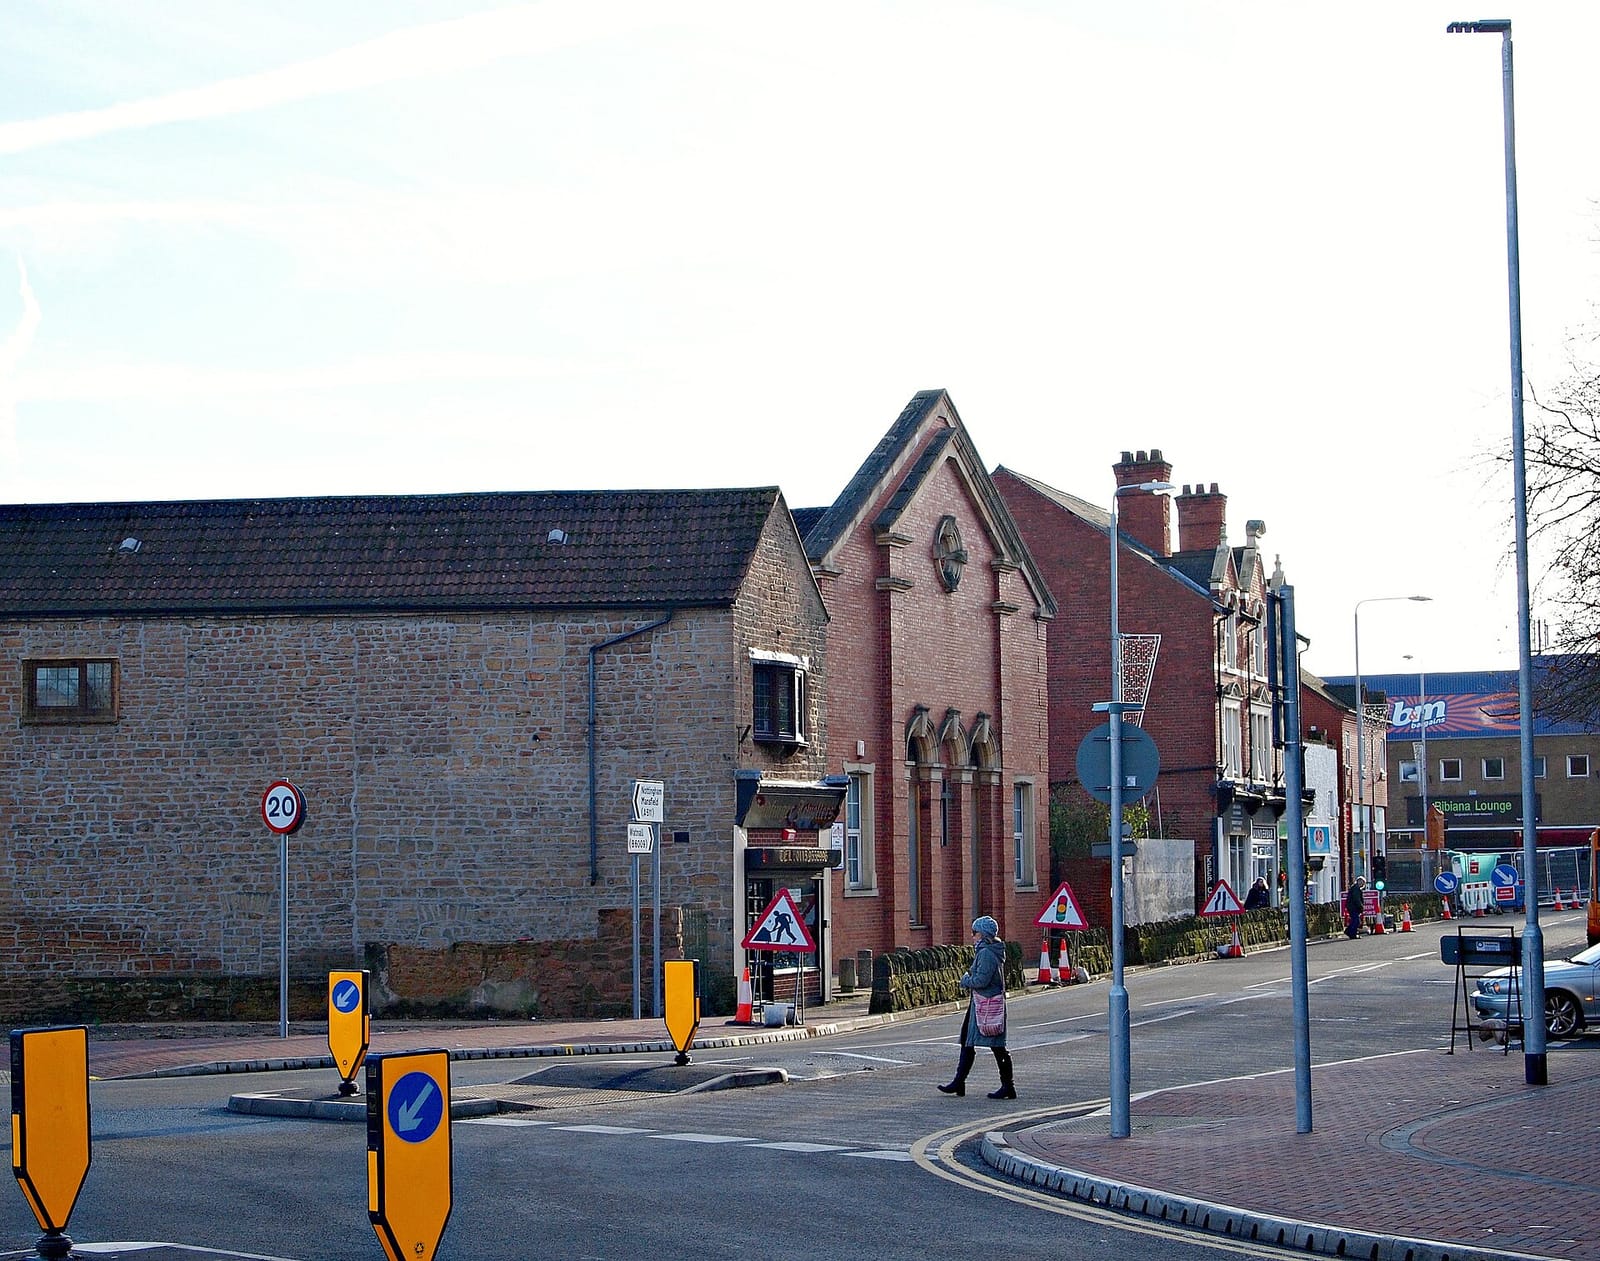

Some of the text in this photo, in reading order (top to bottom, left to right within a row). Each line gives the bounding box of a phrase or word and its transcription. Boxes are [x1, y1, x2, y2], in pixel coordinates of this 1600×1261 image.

[1392, 701, 1446, 727] b&m
[1411, 718, 1446, 729] bagains
[641, 786, 662, 796] Nottingham
[268, 796, 295, 818] 20
[641, 797, 659, 806] Mansfield
[1434, 800, 1512, 814] Bibiana Lounge
[629, 838, 648, 849] (B6009)
